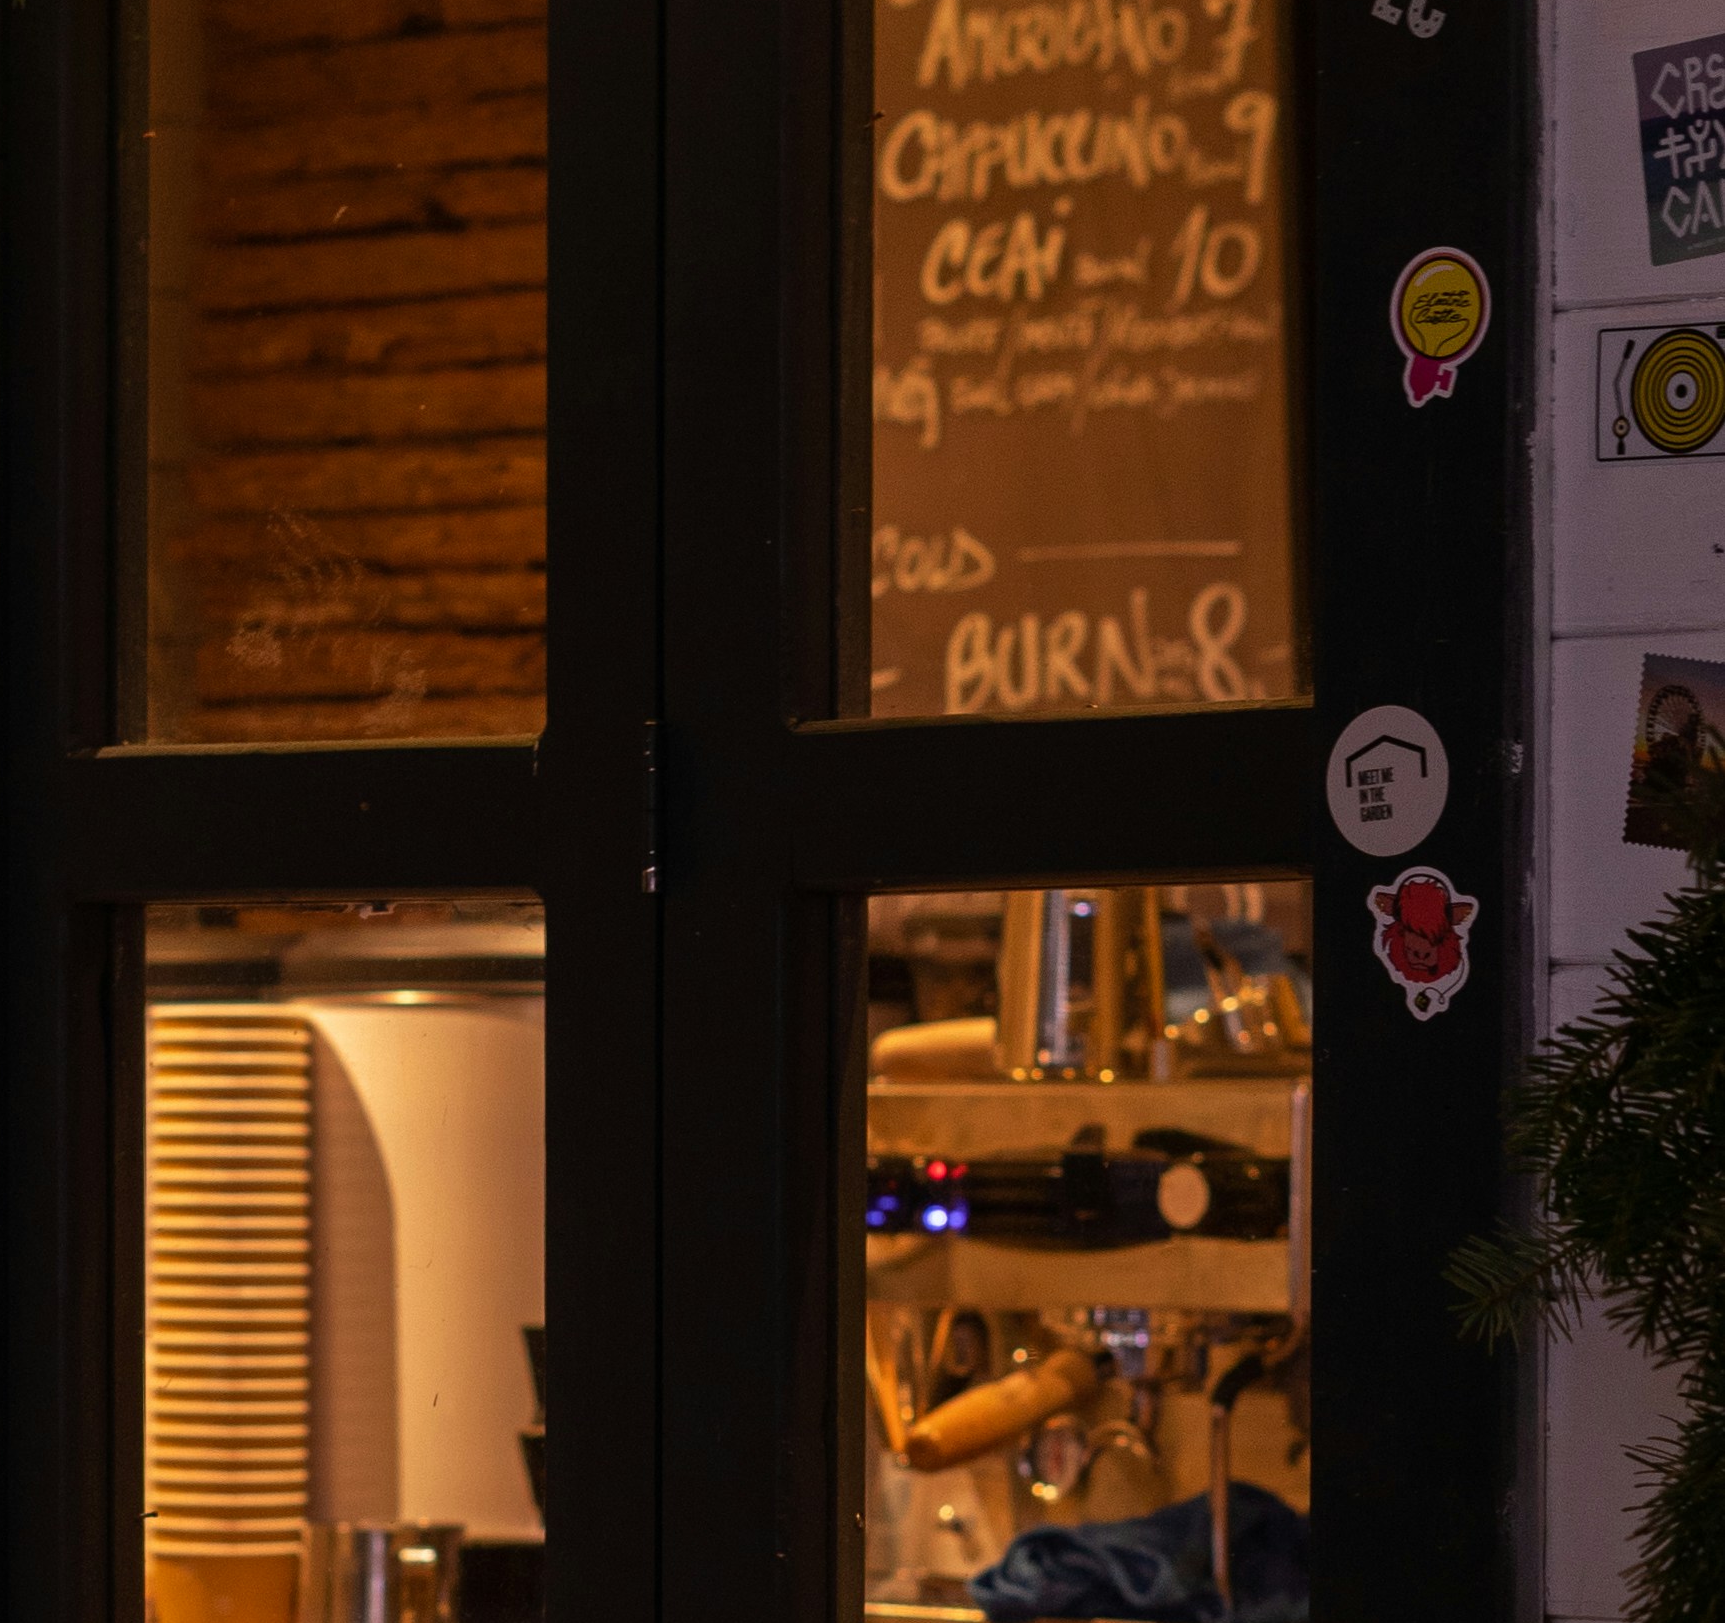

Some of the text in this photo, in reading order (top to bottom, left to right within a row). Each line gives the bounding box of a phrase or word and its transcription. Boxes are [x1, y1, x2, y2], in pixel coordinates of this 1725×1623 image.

[1166, 204, 1263, 313] 10
[1358, 767, 1394, 786] MEET ME
[1359, 786, 1386, 804] IN THE
[1360, 804, 1394, 822] GARDEN
